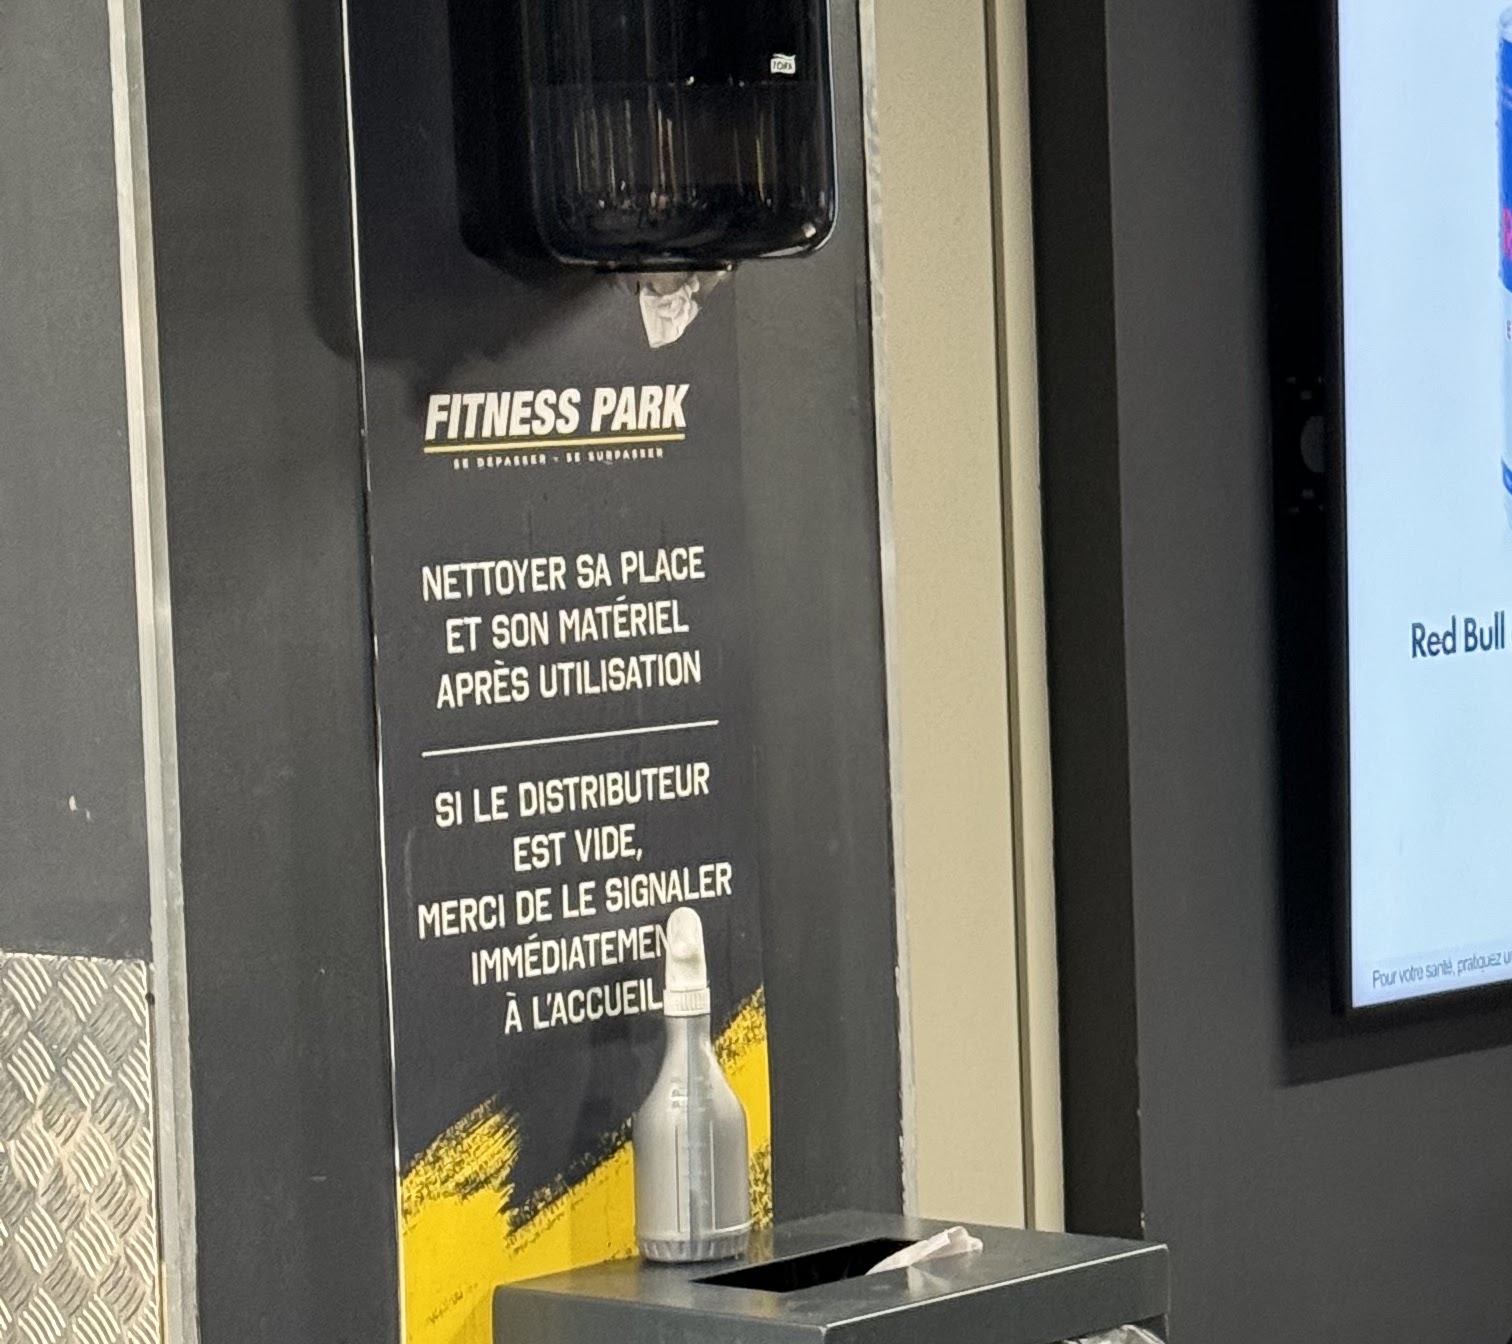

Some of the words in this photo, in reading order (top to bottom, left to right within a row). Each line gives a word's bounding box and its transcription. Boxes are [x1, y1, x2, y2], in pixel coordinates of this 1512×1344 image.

[425, 388, 581, 440] FITNESS
[591, 384, 689, 432] PARK
[422, 556, 566, 601] NETTOYER
[576, 553, 612, 588] SA
[621, 546, 705, 584] PLACE
[446, 617, 482, 654] ET
[492, 611, 549, 649] SON
[559, 595, 689, 644] MATÉRIEL
[1411, 615, 1457, 658] Red
[1464, 610, 1505, 653] Bull
[437, 660, 529, 709] APRÈS
[540, 650, 701, 698] UTILISATION
[435, 791, 462, 827] SI
[474, 786, 509, 823] LE
[519, 762, 709, 817] DISTRIBUTEUR
[514, 832, 566, 872] EST
[575, 823, 642, 862] VIDE,
[418, 894, 505, 939] MERCI
[516, 888, 552, 925] DE
[562, 881, 596, 918] LE
[605, 862, 732, 912] SIGNALER
[472, 924, 668, 986] IMMÉDIATEMEN
[1372, 969, 1398, 989] Pour
[1399, 964, 1424, 983] votre
[1457, 951, 1501, 977] pratiquez
[505, 992, 522, 1034] À
[533, 978, 663, 1029] L'ACCUEIL
